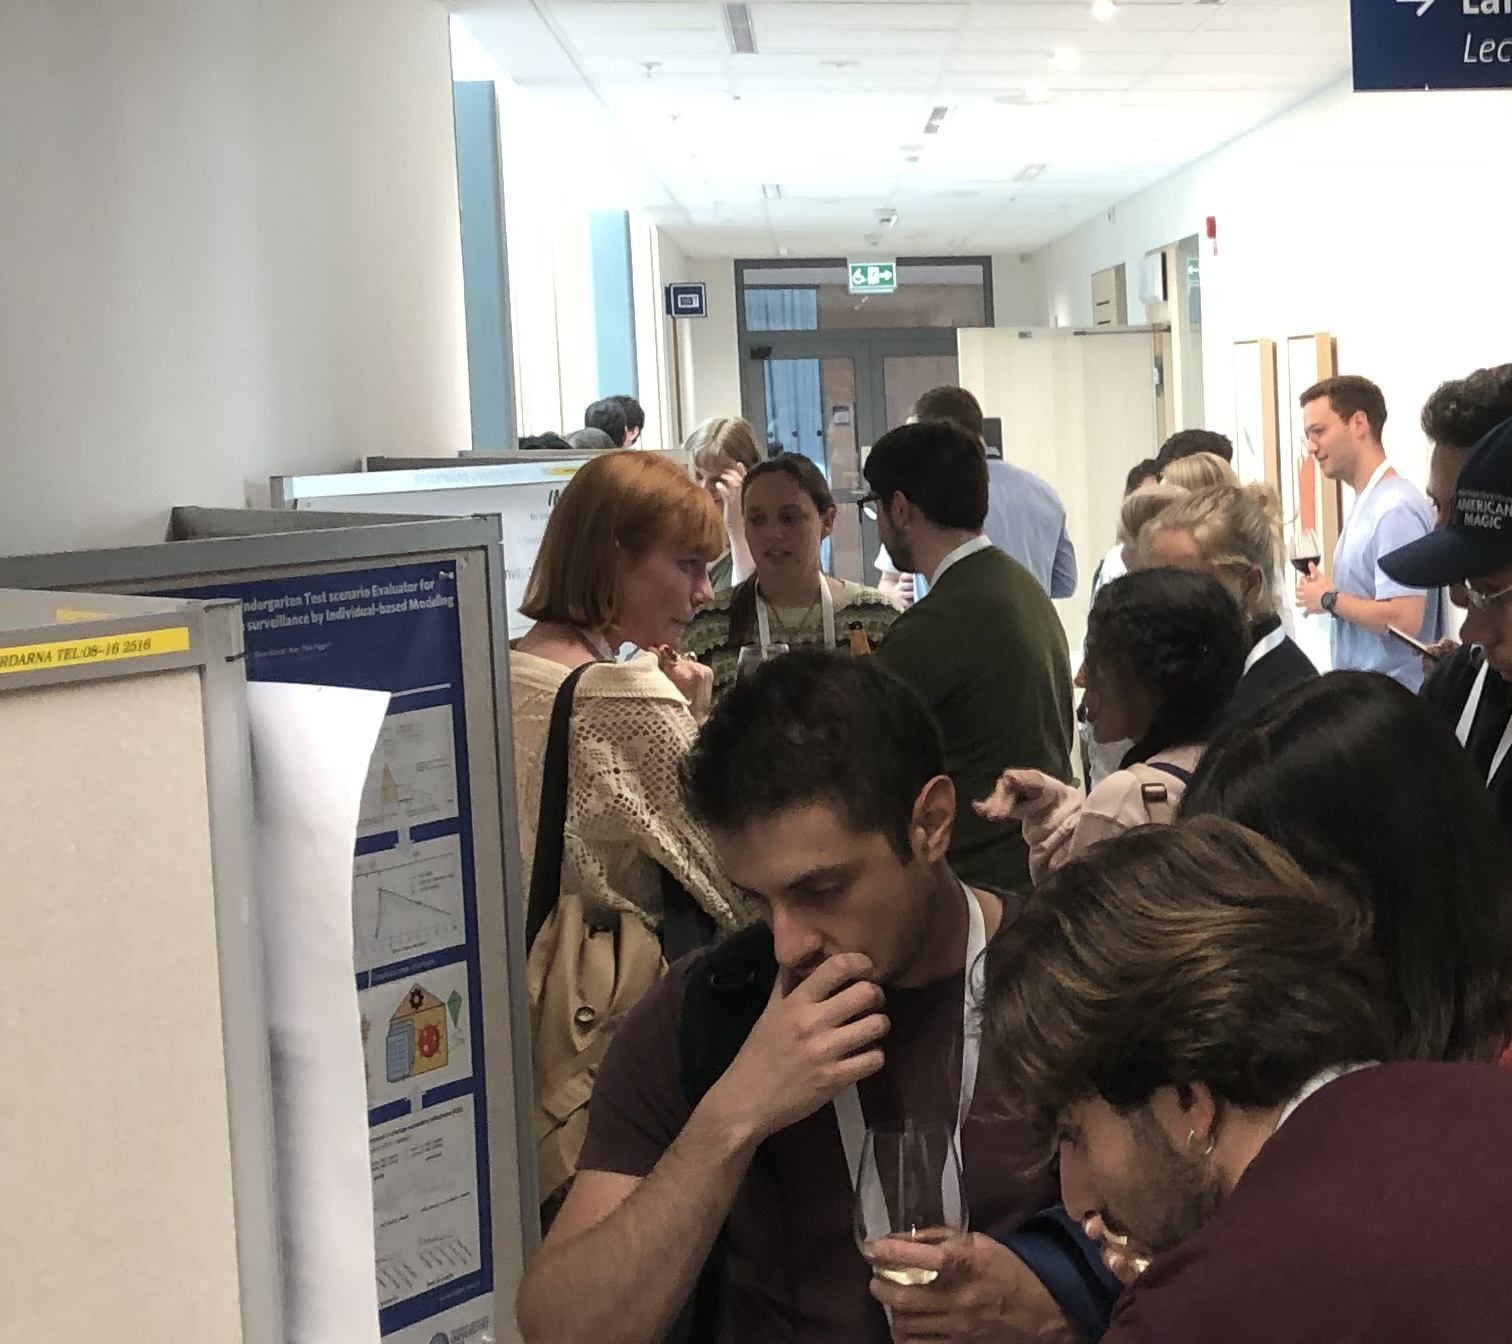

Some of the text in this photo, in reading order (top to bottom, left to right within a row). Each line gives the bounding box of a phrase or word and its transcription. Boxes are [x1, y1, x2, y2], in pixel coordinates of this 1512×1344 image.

[1464, 513, 1502, 530] MAGIC
[304, 592, 327, 605] Test
[328, 585, 371, 603] scenario
[371, 580, 419, 598] Evaluator
[419, 579, 436, 592] for
[246, 611, 310, 632] surveillance
[310, 610, 324, 626] by
